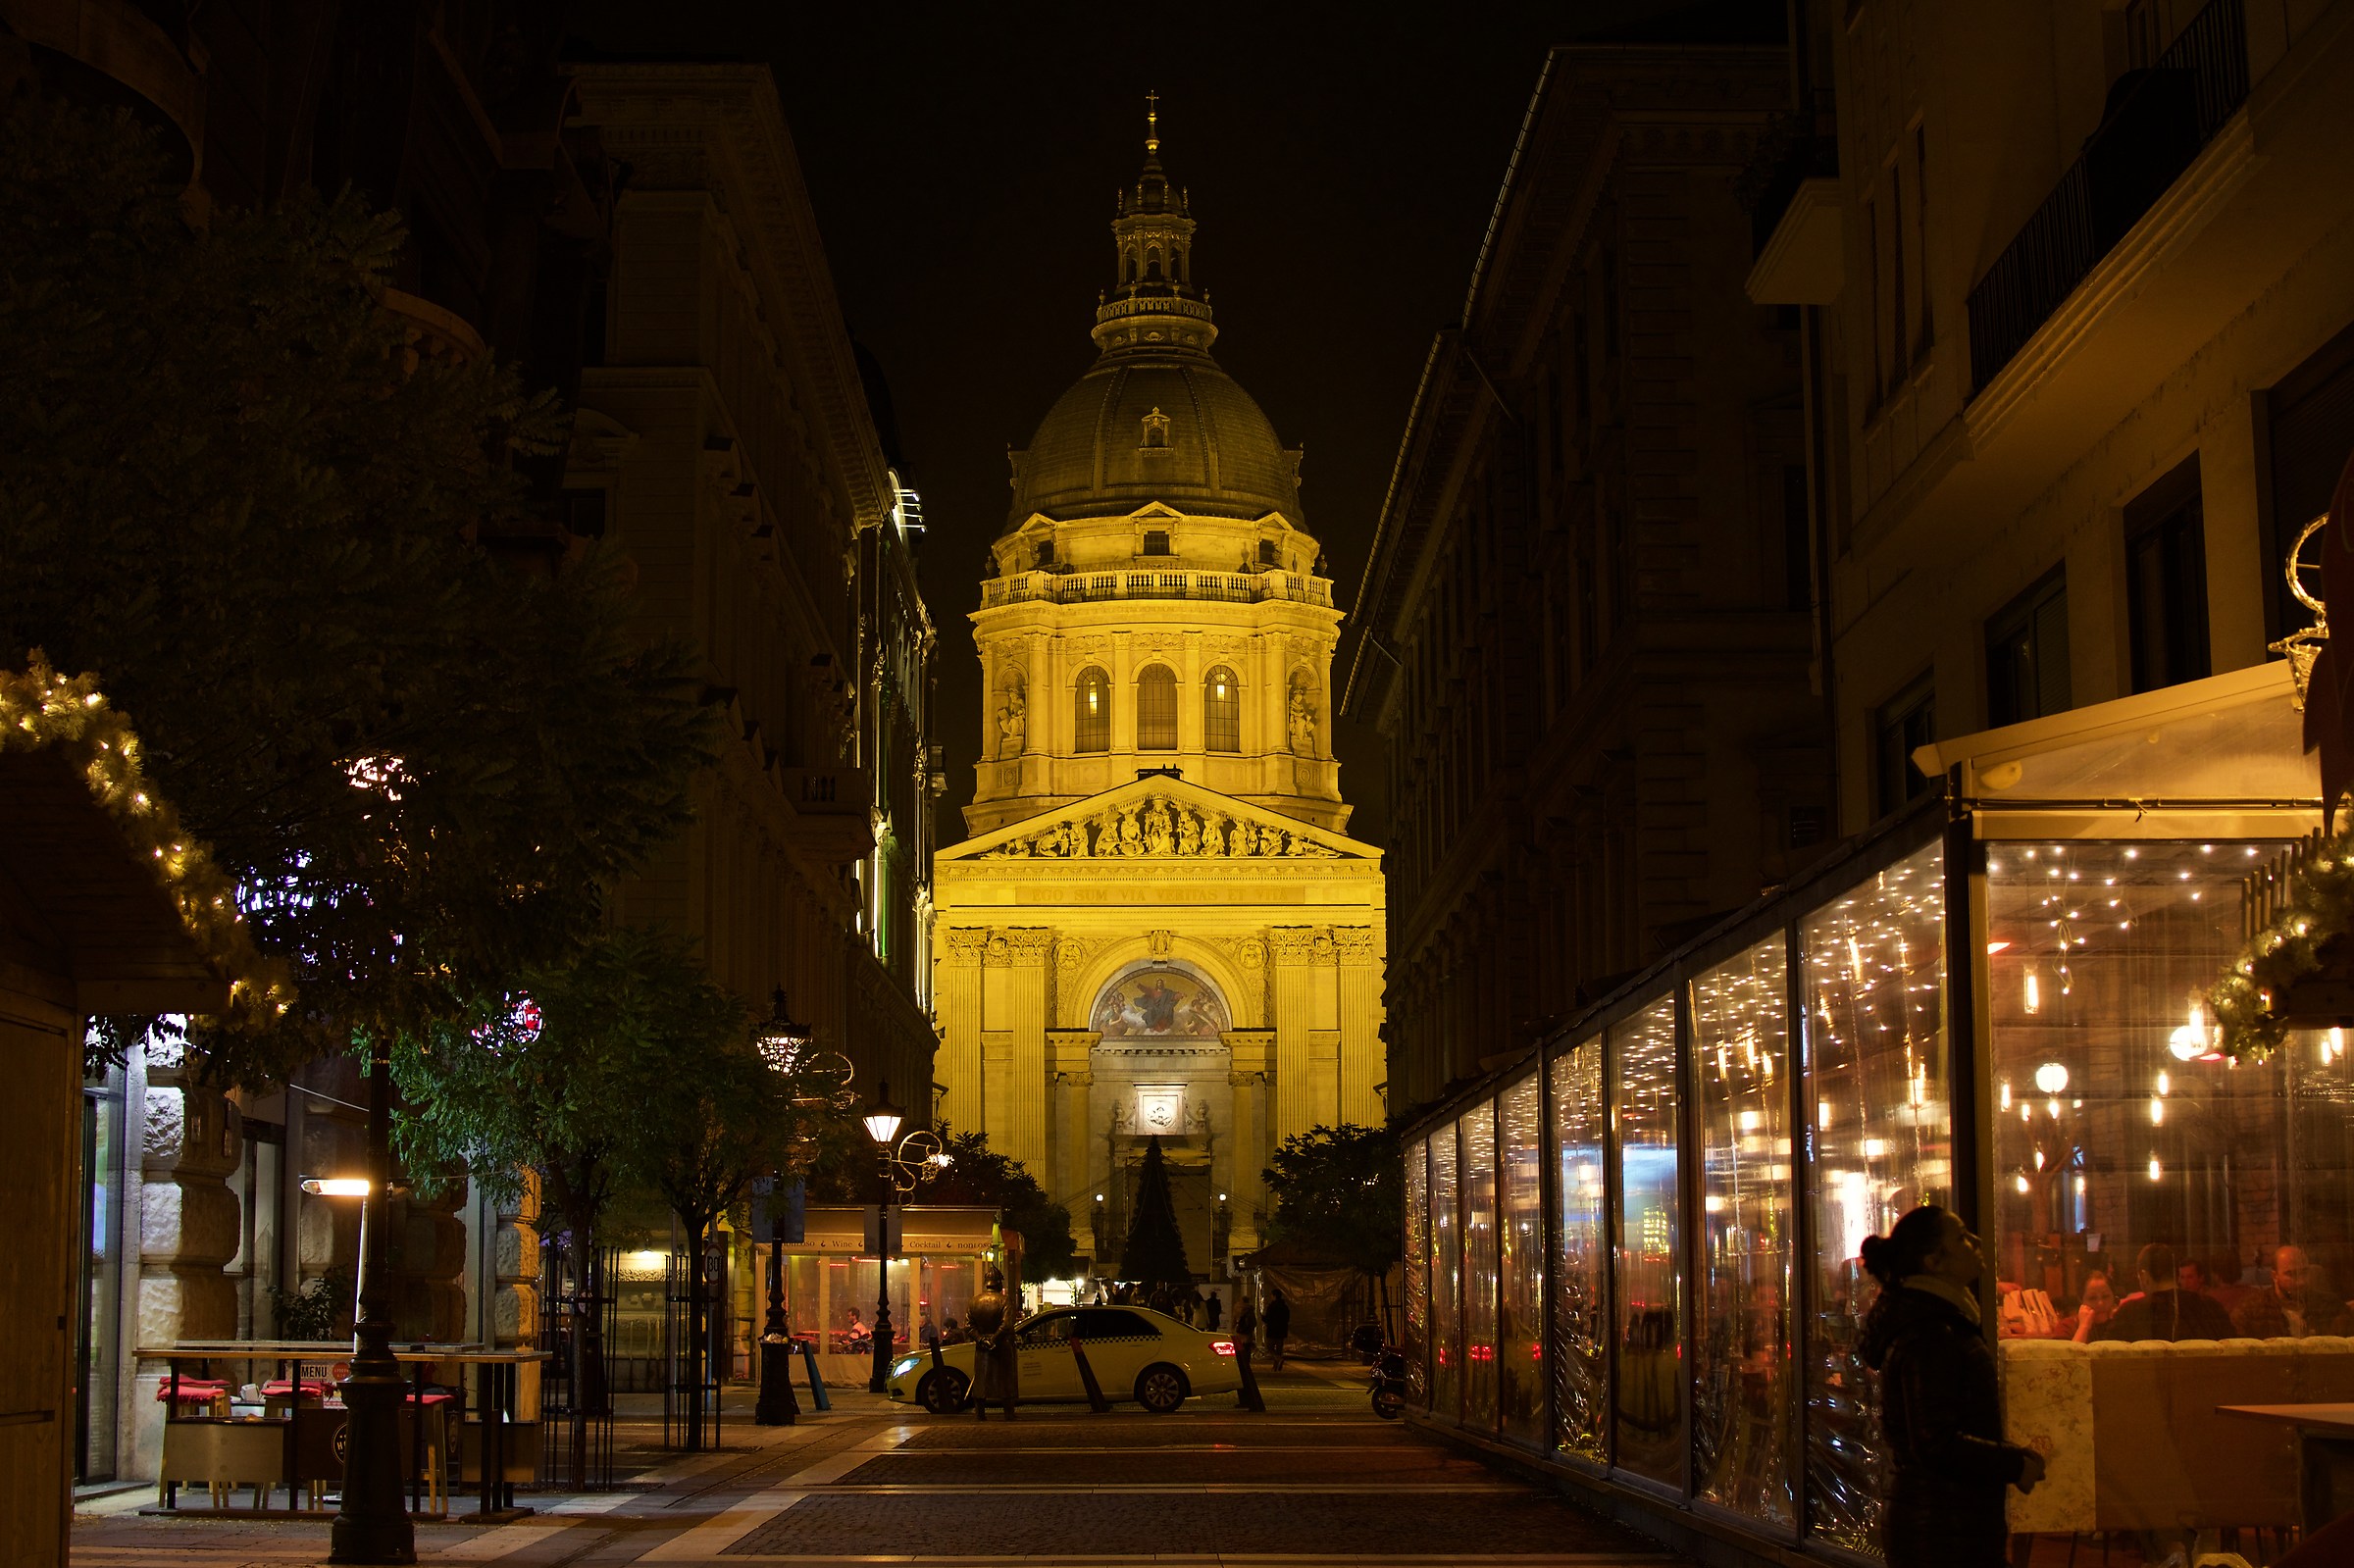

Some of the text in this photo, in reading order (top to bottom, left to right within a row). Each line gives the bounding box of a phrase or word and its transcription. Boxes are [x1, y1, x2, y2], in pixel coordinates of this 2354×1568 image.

[1032, 888, 1288, 901] EGO SUM VIA VERITAS ET VITA
[301, 1366, 328, 1378] MENU
